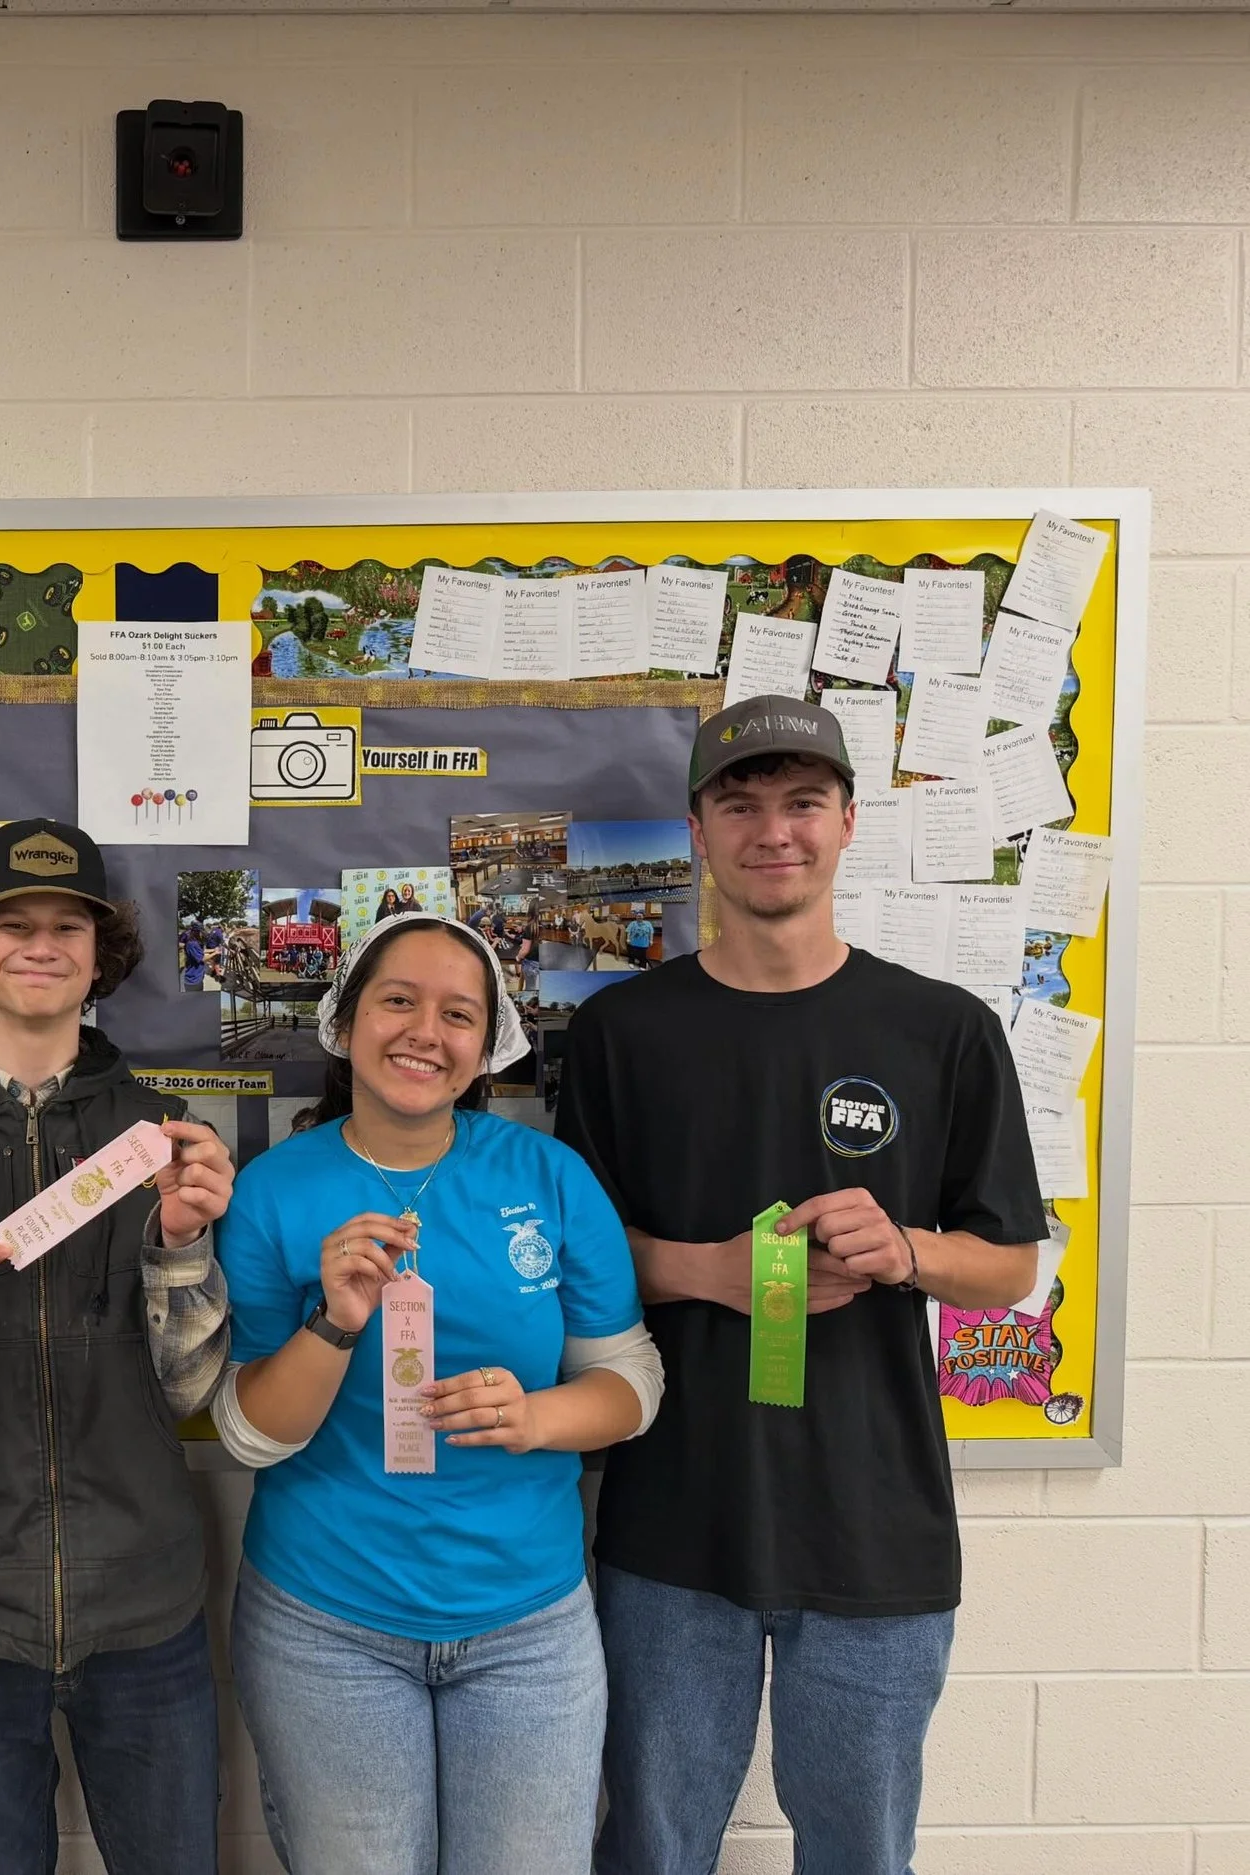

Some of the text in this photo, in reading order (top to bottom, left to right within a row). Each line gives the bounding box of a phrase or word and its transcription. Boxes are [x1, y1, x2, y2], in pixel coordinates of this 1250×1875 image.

[1046, 520, 1095, 544] My Favorites!
[437, 574, 491, 591] My Favorites!
[576, 578, 631, 591] My Favorites!
[661, 576, 714, 590] My Favorites!
[841, 578, 895, 596] My Favorites!
[918, 580, 973, 589] My Favorites!
[505, 589, 560, 599] My Favorites!
[110, 631, 218, 641] FFA Ozark Delight Suckers
[749, 625, 804, 640] My Favorites!
[1009, 626, 1063, 647] My Favorites!
[90, 653, 107, 661] Sold
[928, 677, 982, 693] My Favorites!
[834, 697, 883, 707] My Favorites!
[983, 733, 1037, 758] My Favorites!
[362, 750, 479, 771] Yourself in FFA
[925, 786, 979, 797] My Favorites!
[860, 799, 900, 808] Favorites!
[1042, 834, 1102, 850] My Favorites!
[14, 850, 75, 866] Wrangler
[884, 889, 938, 901] My Favorites!
[959, 895, 1013, 905] My Favorites!
[1032, 1007, 1088, 1030] My Favorites!
[196, 1078, 267, 1089] Officer Team
[831, 1097, 886, 1114] PEOTONE
[831, 1106, 883, 1132] FFA
[126, 1134, 155, 1169] SECTION
[125, 1156, 134, 1165] X
[109, 1160, 125, 1178] FFA
[23, 1215, 46, 1241] FOURTH
[15, 1224, 34, 1248] PLACE
[761, 1233, 800, 1246] SECTION
[776, 1249, 784, 1260] X
[771, 1263, 789, 1275] FFA
[389, 1301, 426, 1312] SECTION
[405, 1316, 411, 1327] X
[400, 1331, 416, 1341] FFA
[953, 1324, 1040, 1350] STAY
[943, 1348, 1050, 1375] POSITIVE
[395, 1431, 424, 1441] FOURTH
[399, 1443, 420, 1452] PLACE
